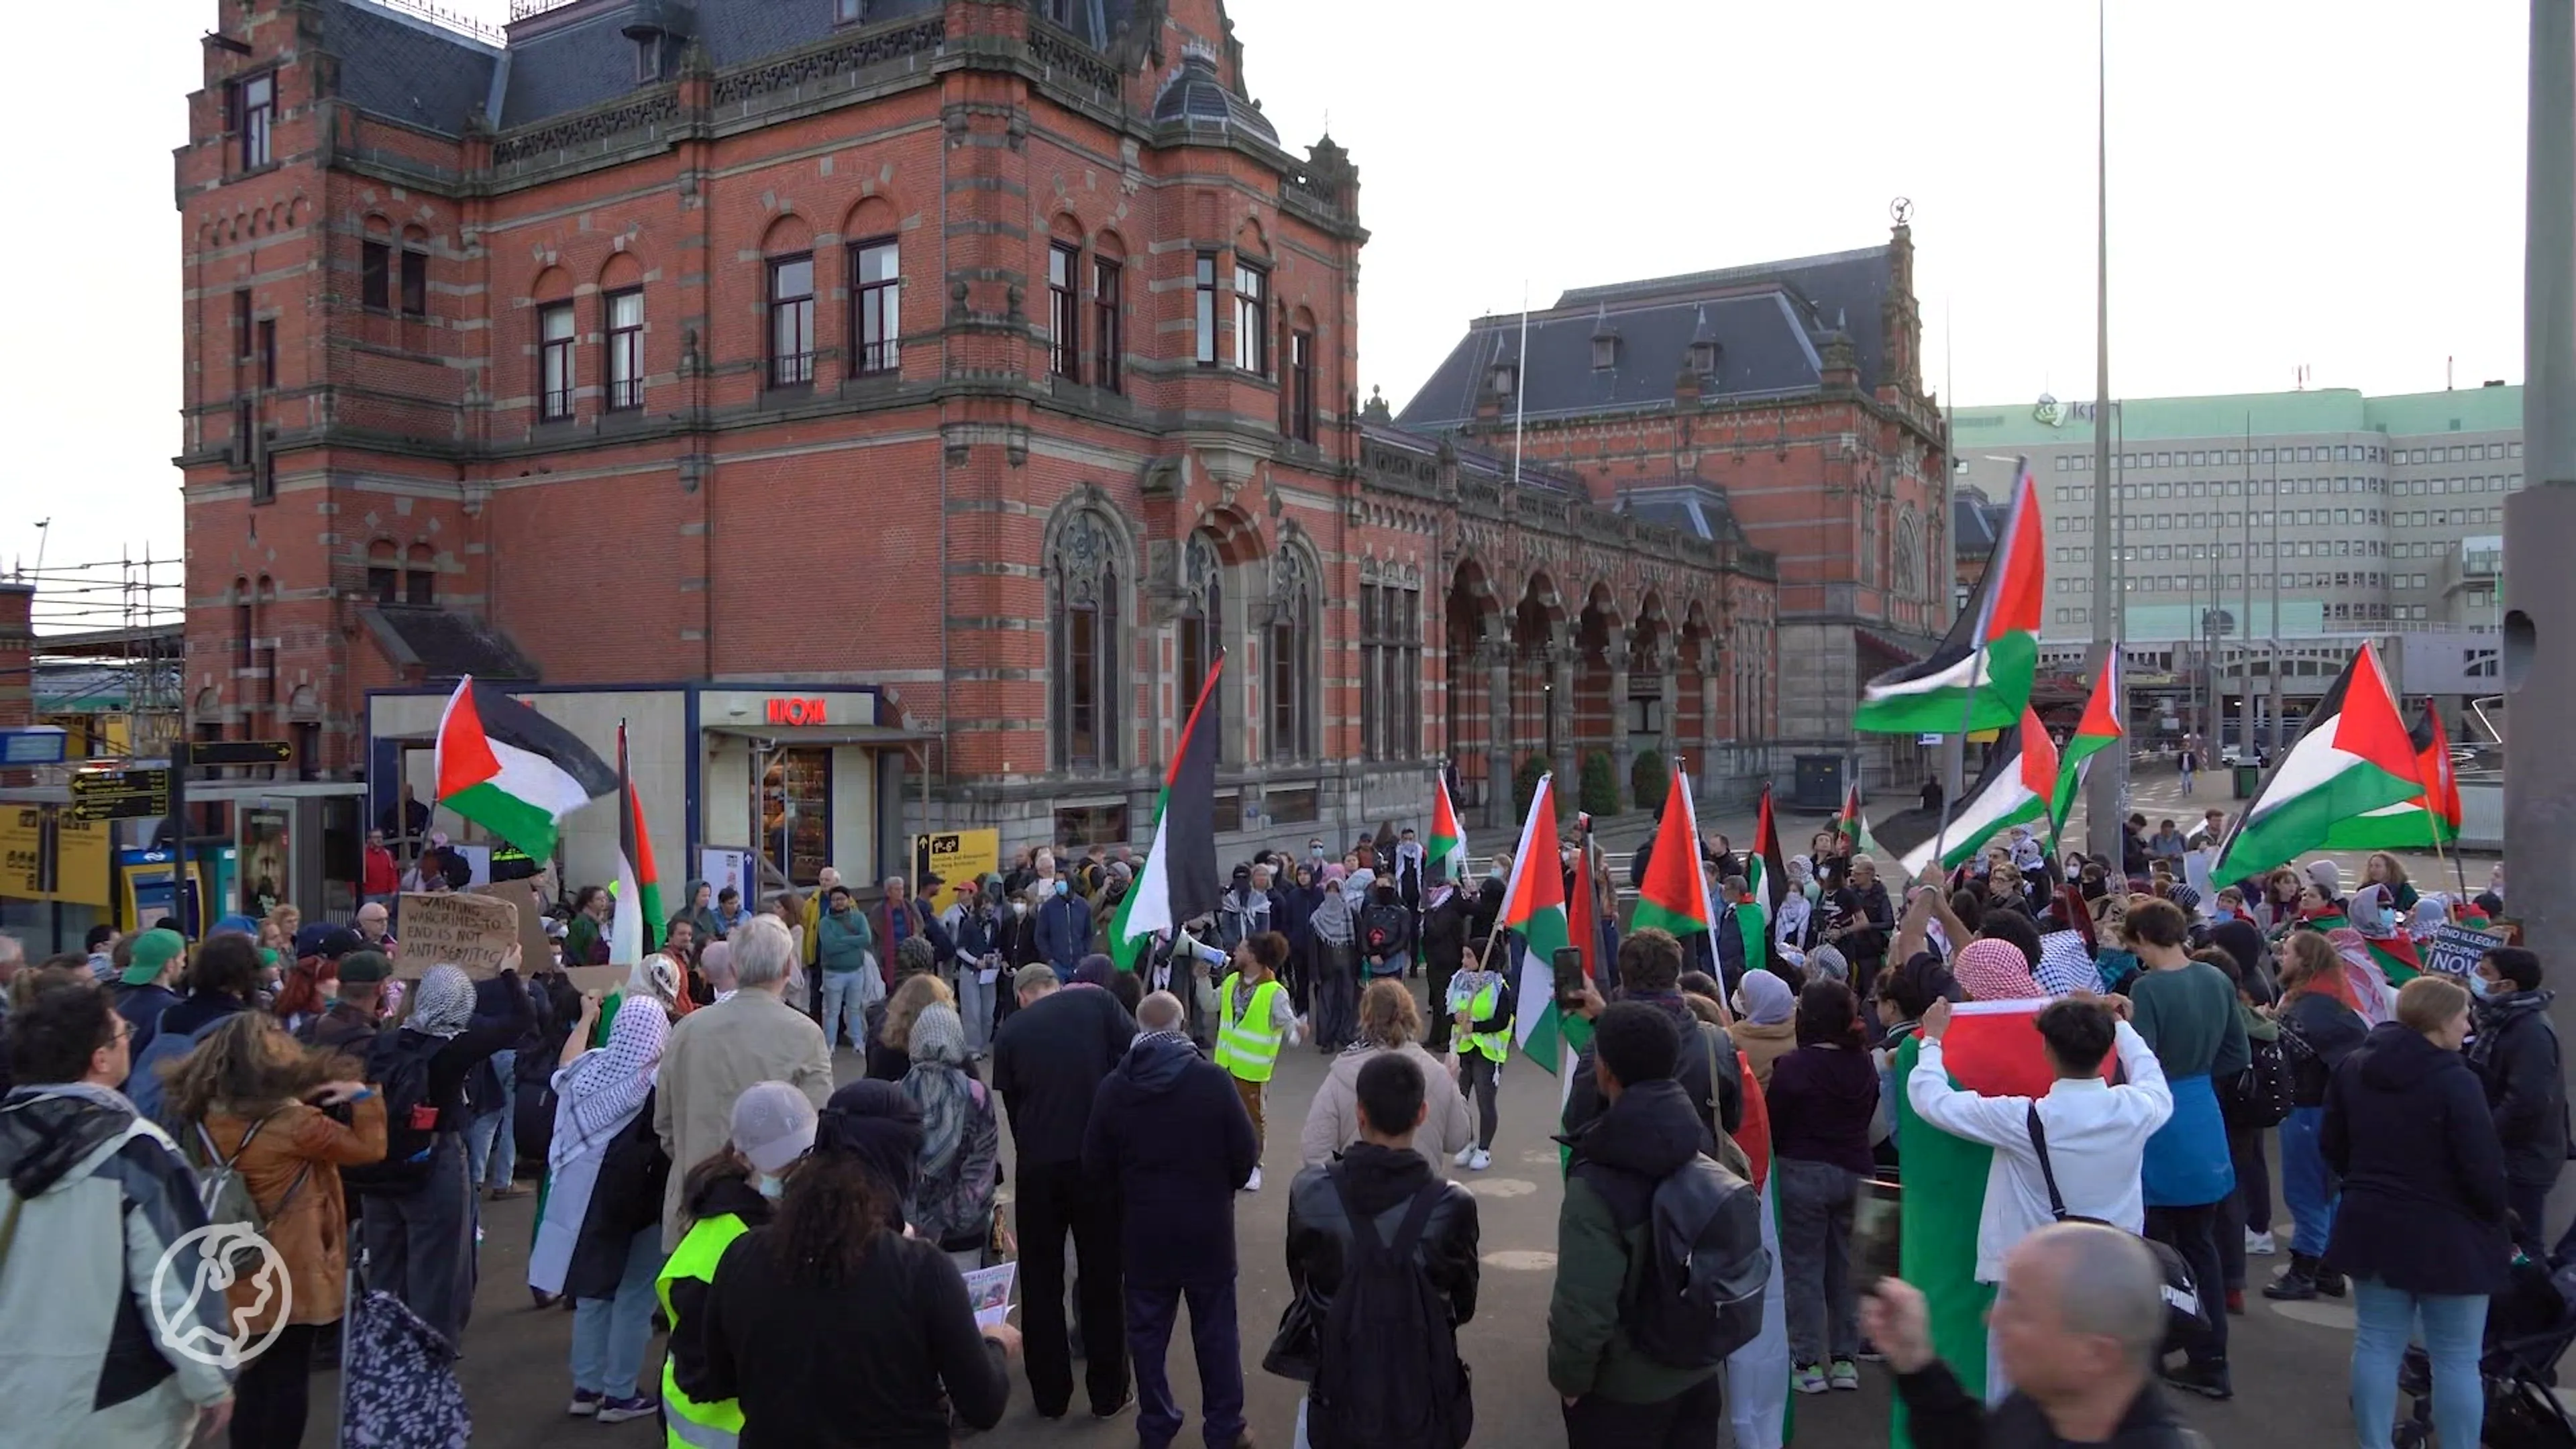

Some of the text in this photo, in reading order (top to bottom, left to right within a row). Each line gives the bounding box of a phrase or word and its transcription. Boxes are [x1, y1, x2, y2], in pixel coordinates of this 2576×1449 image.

[768, 698, 826, 725] KIOSK
[418, 897, 480, 916] WANTING
[483, 919, 501, 930] TO
[2438, 927, 2461, 939] END
[407, 926, 484, 943] END IS NOT
[2434, 941, 2483, 959] OCCUPAT
